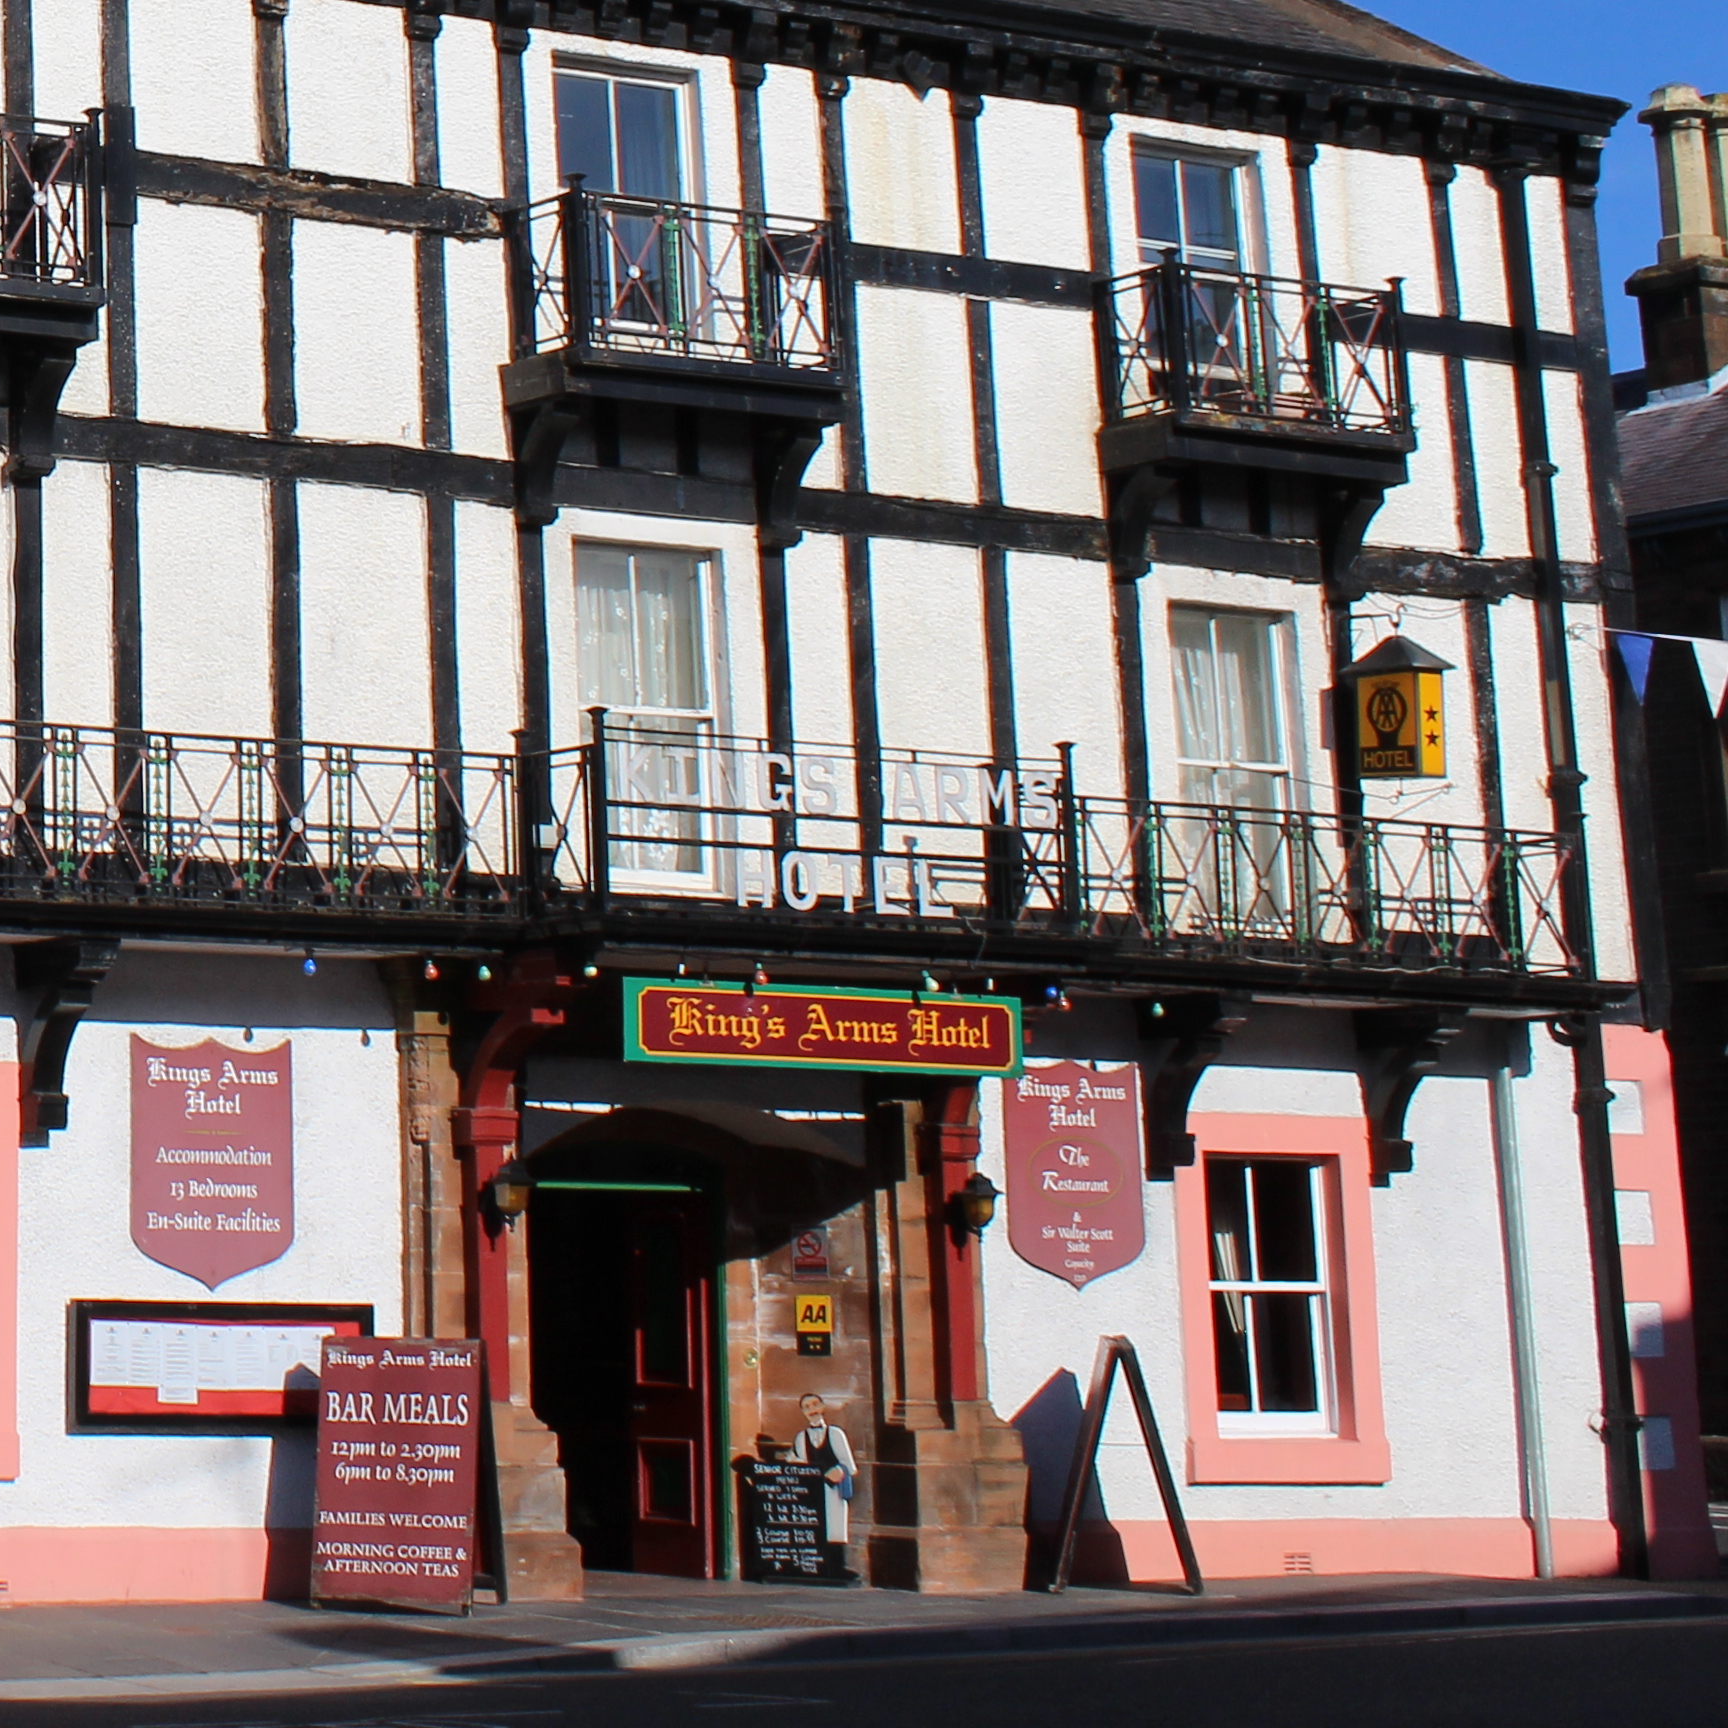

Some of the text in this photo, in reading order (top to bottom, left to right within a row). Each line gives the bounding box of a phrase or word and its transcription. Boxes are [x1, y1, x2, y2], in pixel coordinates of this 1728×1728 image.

[1364, 750, 1414, 768] HOTEL
[618, 743, 1061, 829] KINGS ARMS
[736, 849, 954, 919] HOTEL
[666, 997, 992, 1057] King's Arms Hotel
[146, 1057, 279, 1090] Kings Arms
[1017, 1074, 1127, 1105] Kings Arms
[185, 1090, 242, 1120] Hotel
[1048, 1104, 1097, 1131] Hotel
[155, 1145, 272, 1166] Accommodation
[1059, 1145, 1090, 1167] The
[170, 1178, 259, 1200] 13 Bedrooms
[1042, 1170, 1109, 1193] Restaurant
[147, 1207, 282, 1233] En-Suite Facilities
[1072, 1211, 1081, 1223] &
[1042, 1224, 1114, 1241] Sir Walter Scott
[1066, 1240, 1090, 1253] Suite
[801, 1304, 827, 1324] AA
[326, 1348, 472, 1371] Kings Arms Hotel
[326, 1391, 469, 1426] BAR MEALS
[331, 1440, 461, 1464] 12pm to 2.30pm
[335, 1461, 455, 1488] 6pm to 8.30pm
[319, 1510, 468, 1529] FAMILIES WELCOME
[316, 1541, 467, 1561] MORNING COFFEE &
[323, 1559, 460, 1577] AFTERNOON TEAS
